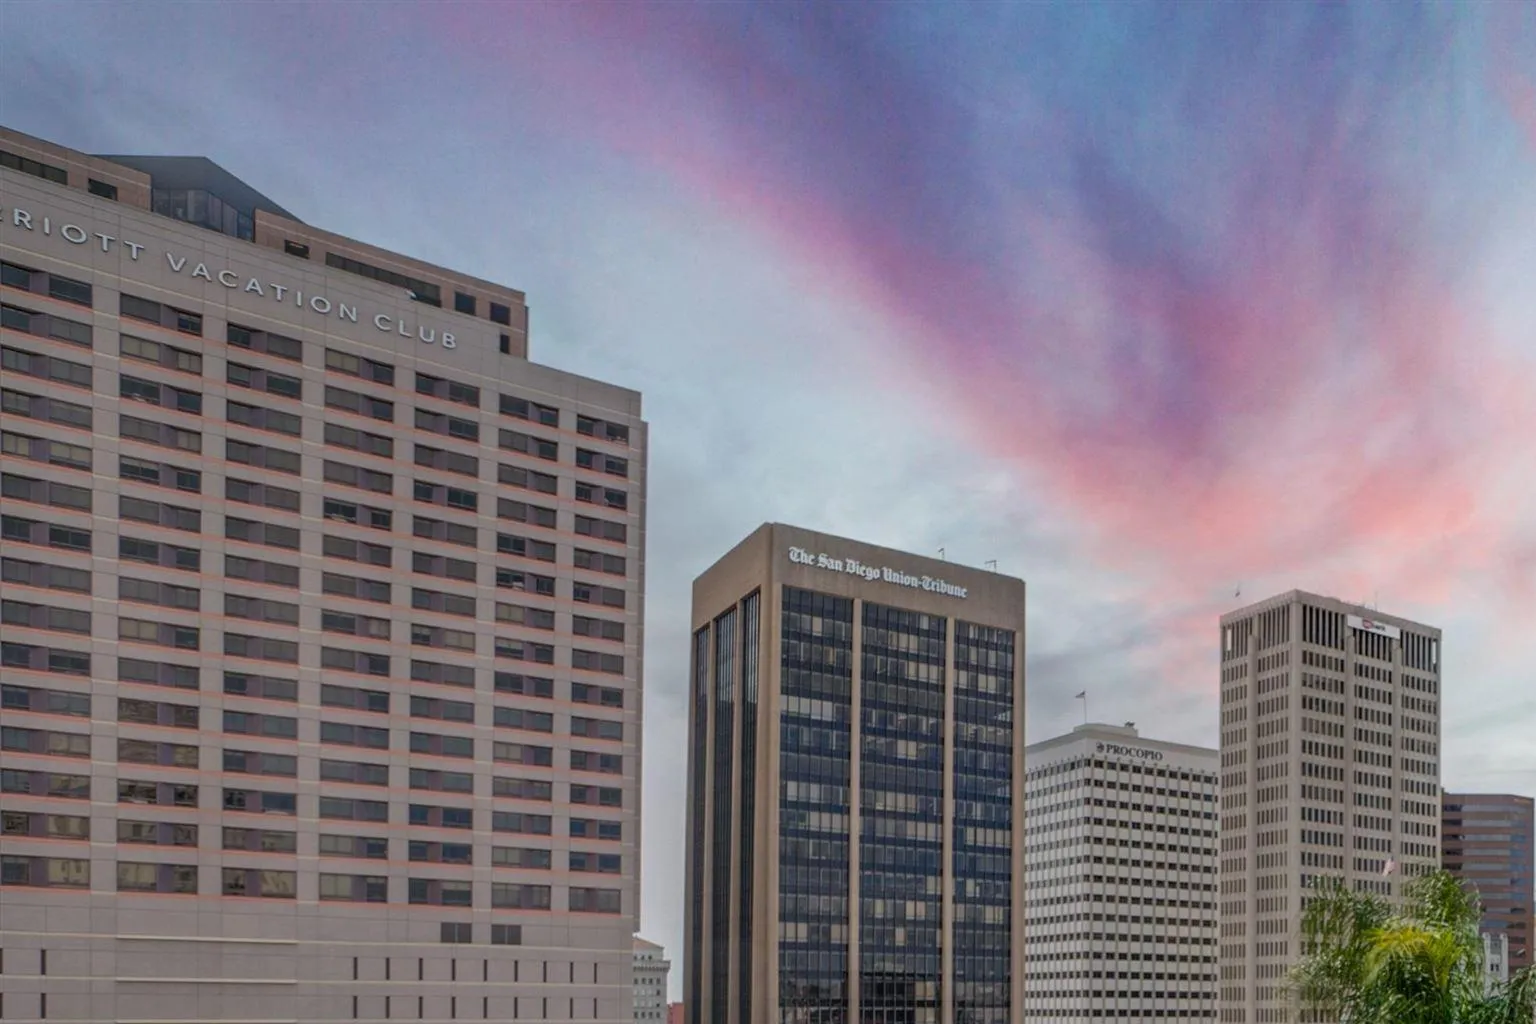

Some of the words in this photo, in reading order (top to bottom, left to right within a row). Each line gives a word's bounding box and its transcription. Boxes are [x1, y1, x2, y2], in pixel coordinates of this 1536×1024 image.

[0, 207, 145, 260] RIOTT
[166, 251, 358, 322] VACATION
[374, 313, 457, 349] CLUB
[788, 546, 815, 565] The
[816, 552, 844, 571] San
[845, 557, 880, 581] Diego
[882, 566, 968, 598] Union-Tribune
[1106, 743, 1164, 761] PROCOPIO
